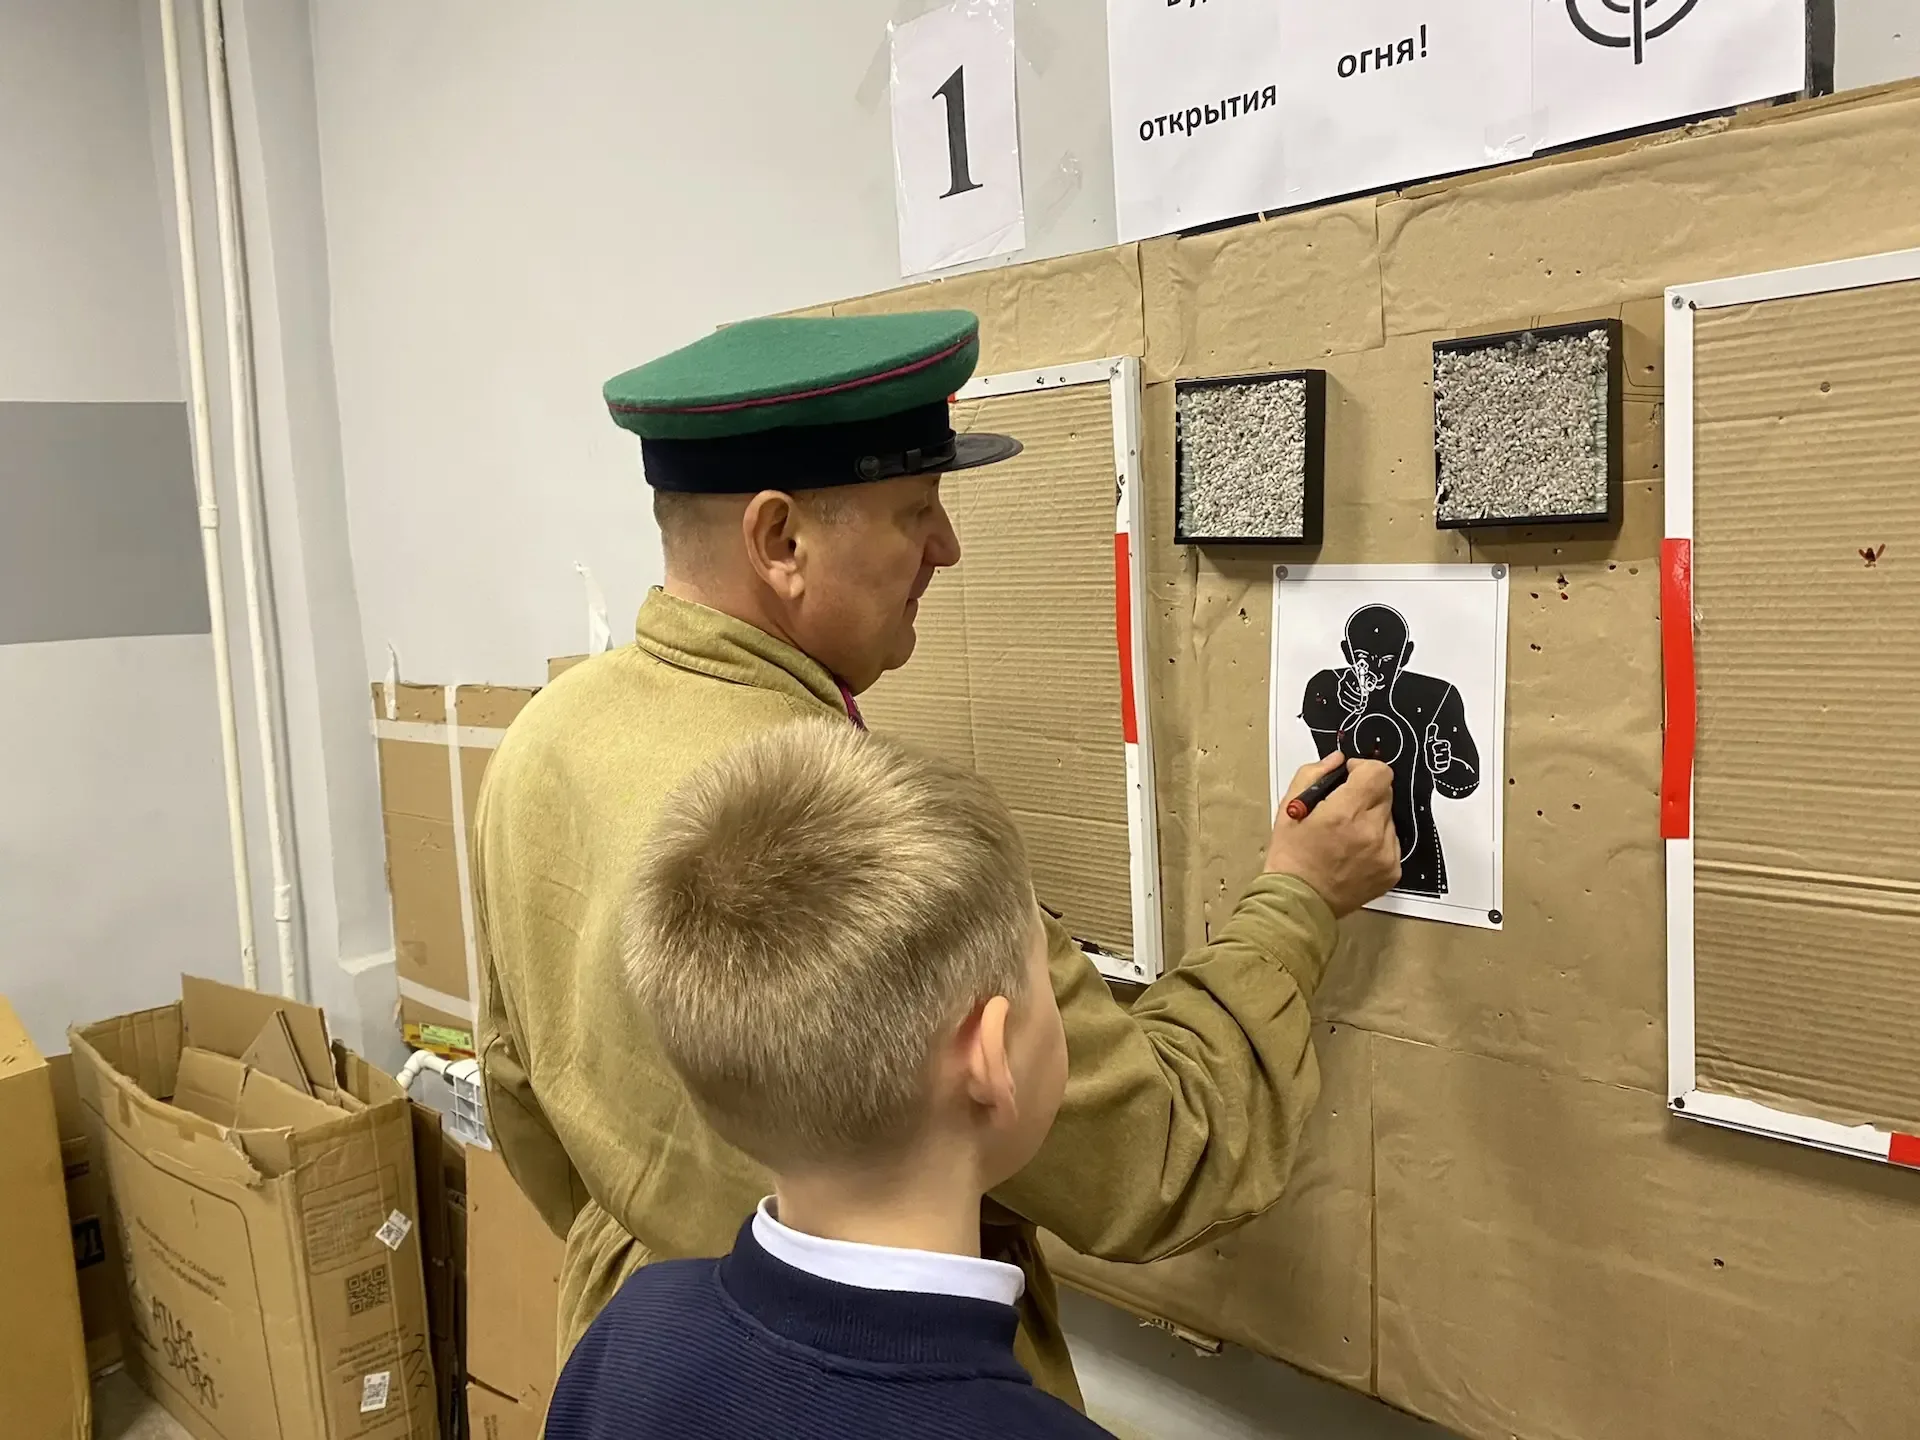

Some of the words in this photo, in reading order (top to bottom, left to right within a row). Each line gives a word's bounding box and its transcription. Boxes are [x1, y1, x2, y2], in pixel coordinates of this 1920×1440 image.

[931, 64, 984, 200] 1
[1139, 84, 1276, 141] открытия
[1337, 23, 1428, 78] огня!
